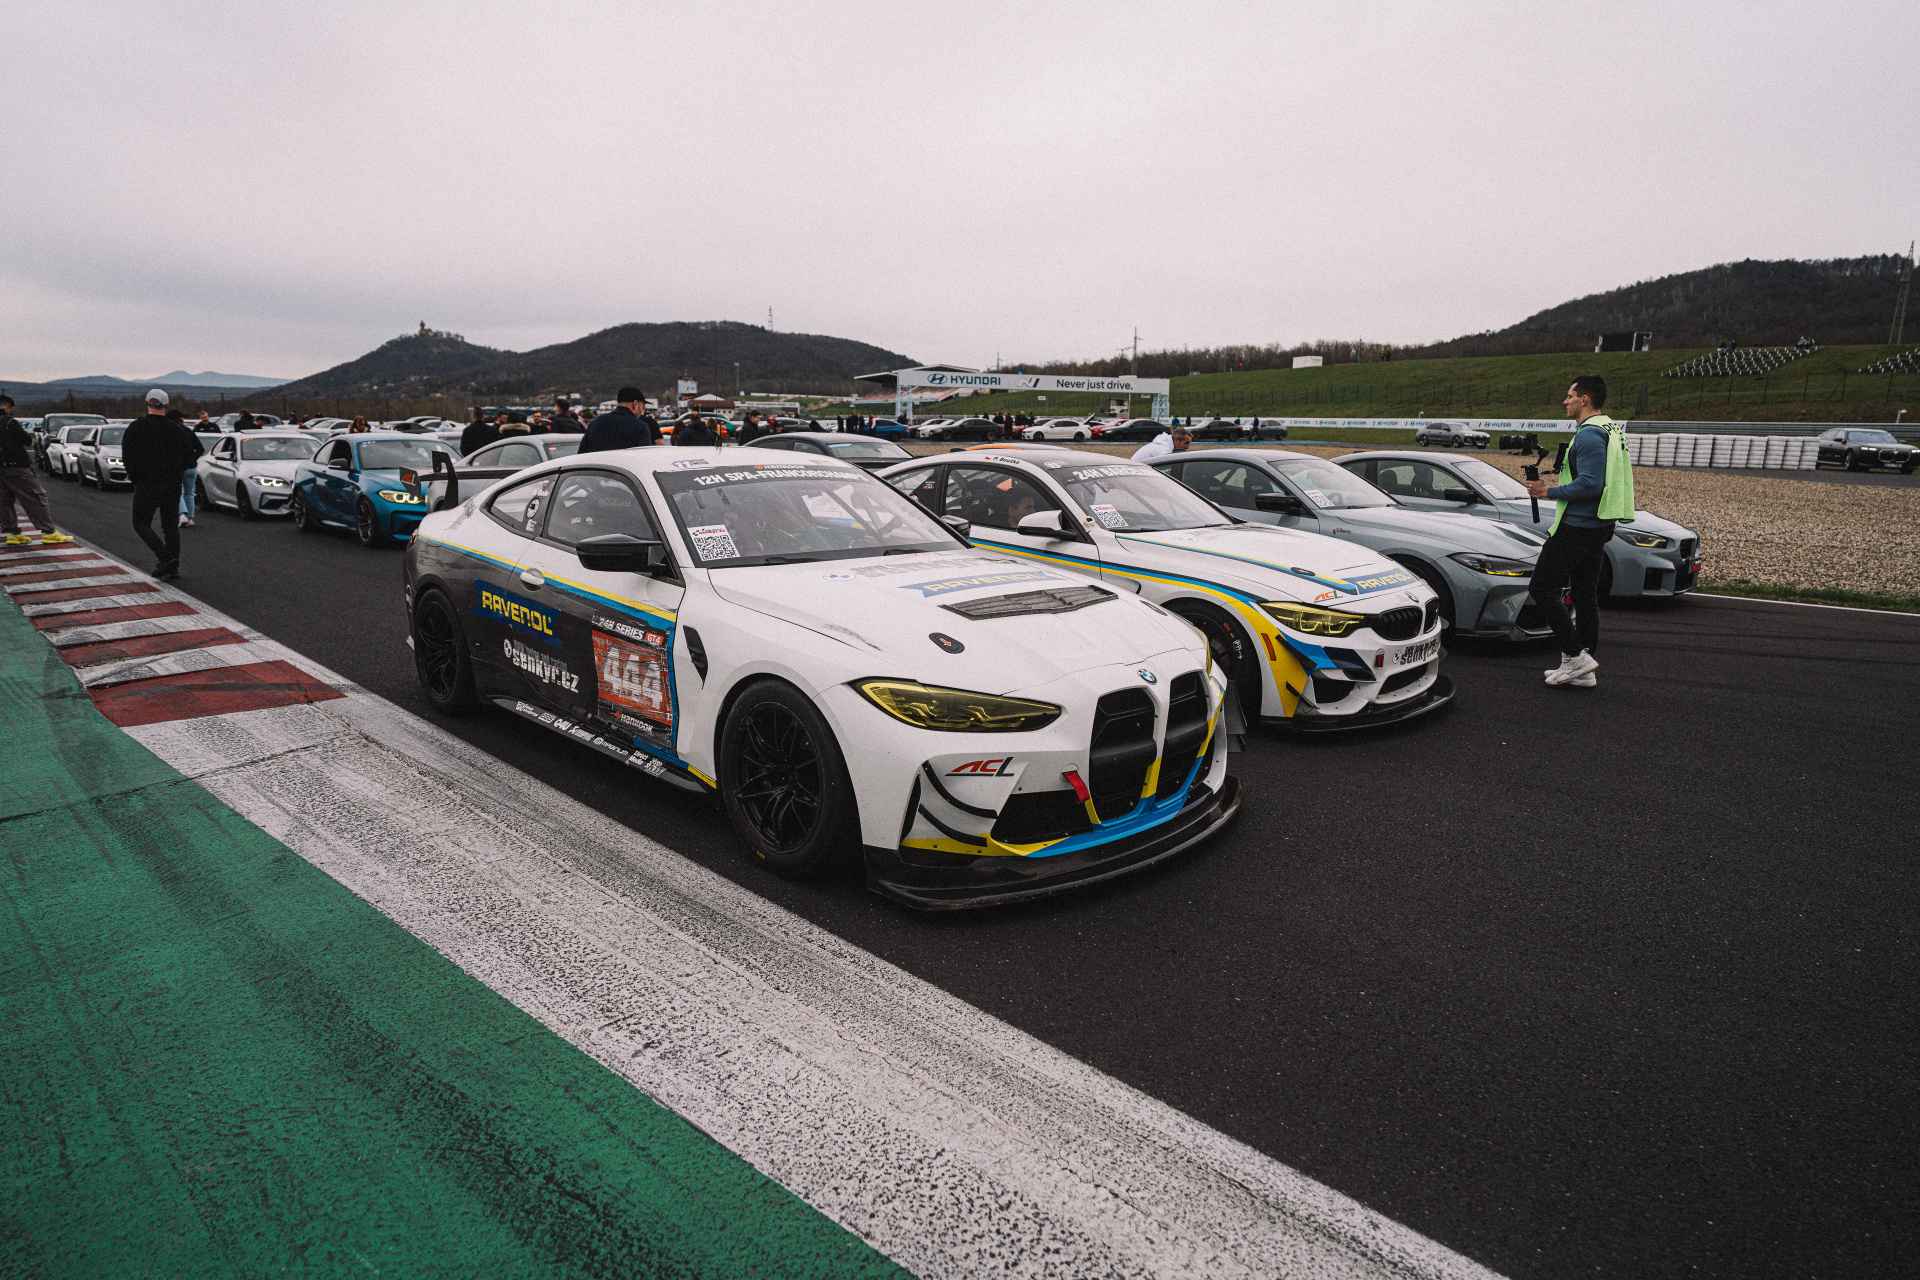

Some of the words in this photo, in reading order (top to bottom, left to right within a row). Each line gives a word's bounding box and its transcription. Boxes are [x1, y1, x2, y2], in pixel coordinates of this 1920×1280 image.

[950, 376, 1001, 385] HYUNDAI
[1056, 379, 1085, 389] Never
[1087, 380, 1105, 391] just
[1107, 380, 1134, 391] drive.
[693, 473, 726, 486] 12H
[1072, 468, 1104, 481] 24H
[481, 590, 553, 636] RAVENOL
[615, 622, 645, 641] SERIES
[603, 647, 664, 711] 444
[946, 756, 1015, 776] ACL
